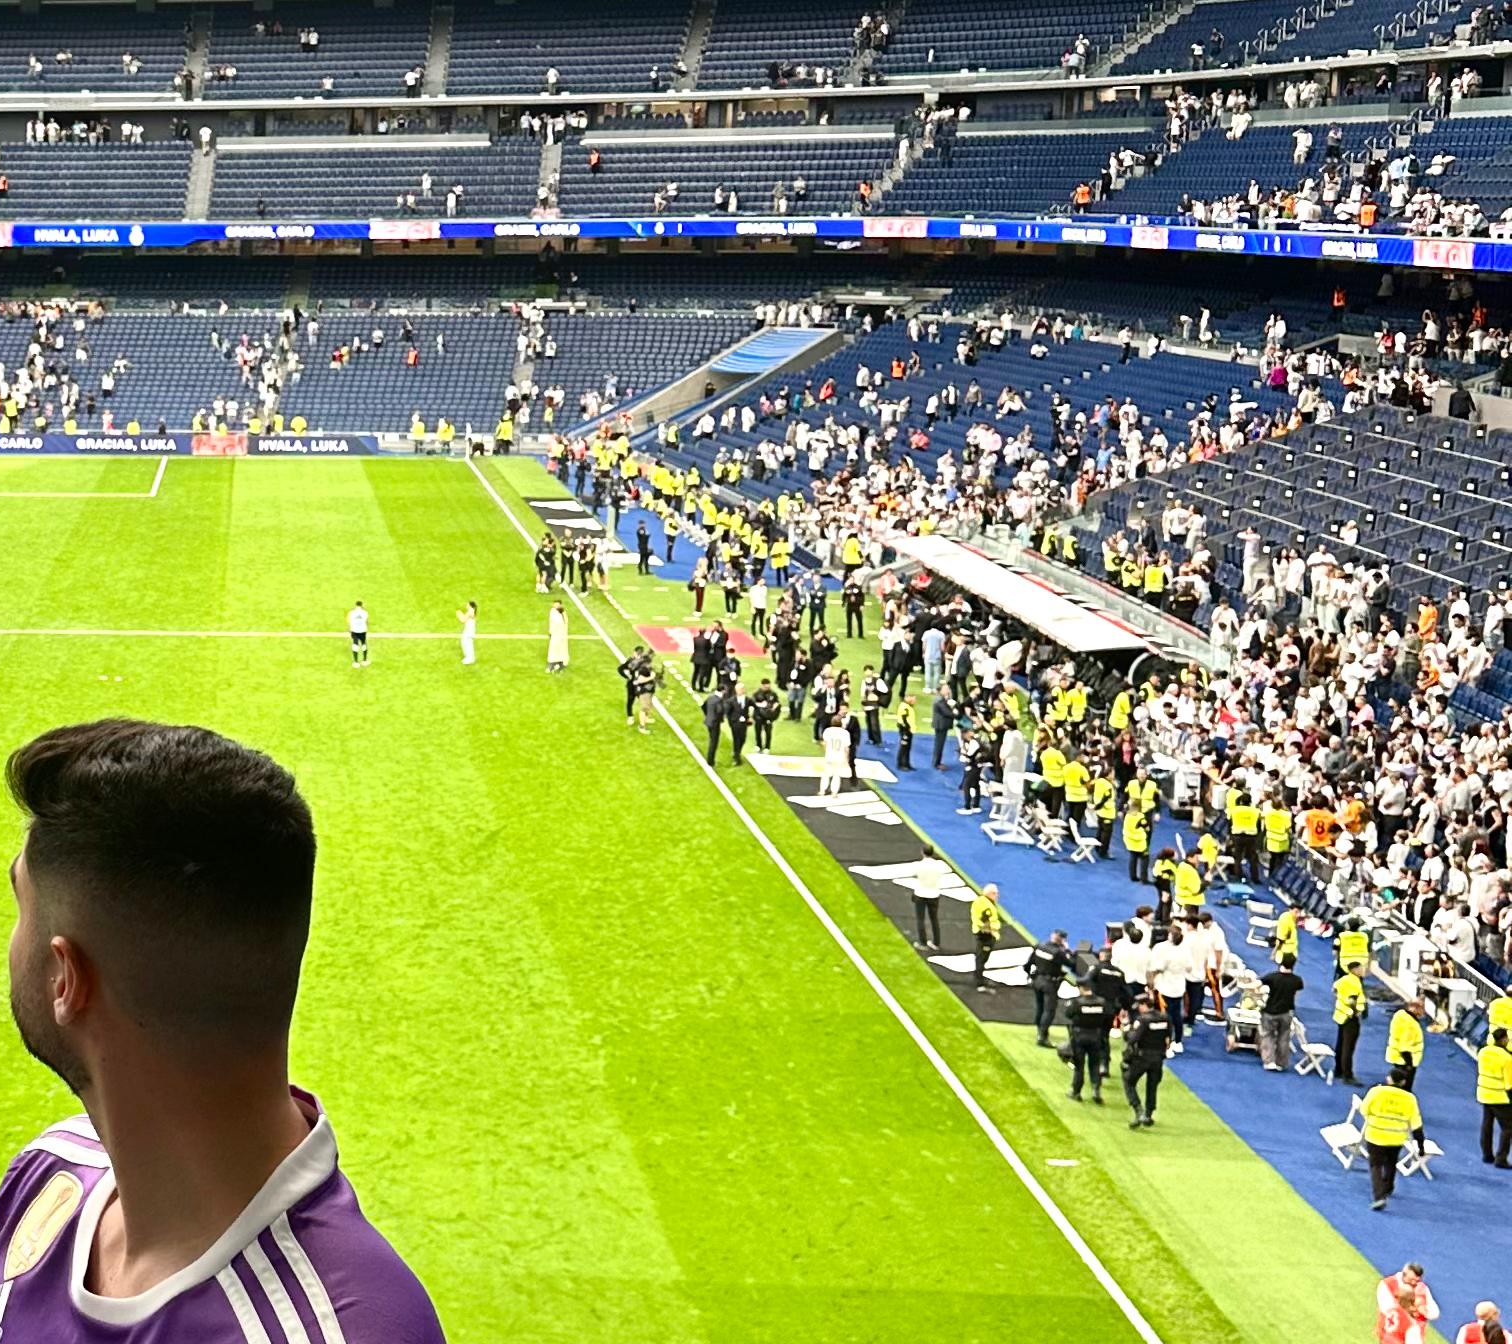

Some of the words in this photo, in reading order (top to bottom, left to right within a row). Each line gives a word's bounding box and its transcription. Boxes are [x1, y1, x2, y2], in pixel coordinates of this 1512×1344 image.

[75, 438, 137, 451] GRACIAS,
[140, 439, 176, 451] LUKA
[258, 440, 307, 453] HVALA,
[311, 440, 348, 452] LUKA
